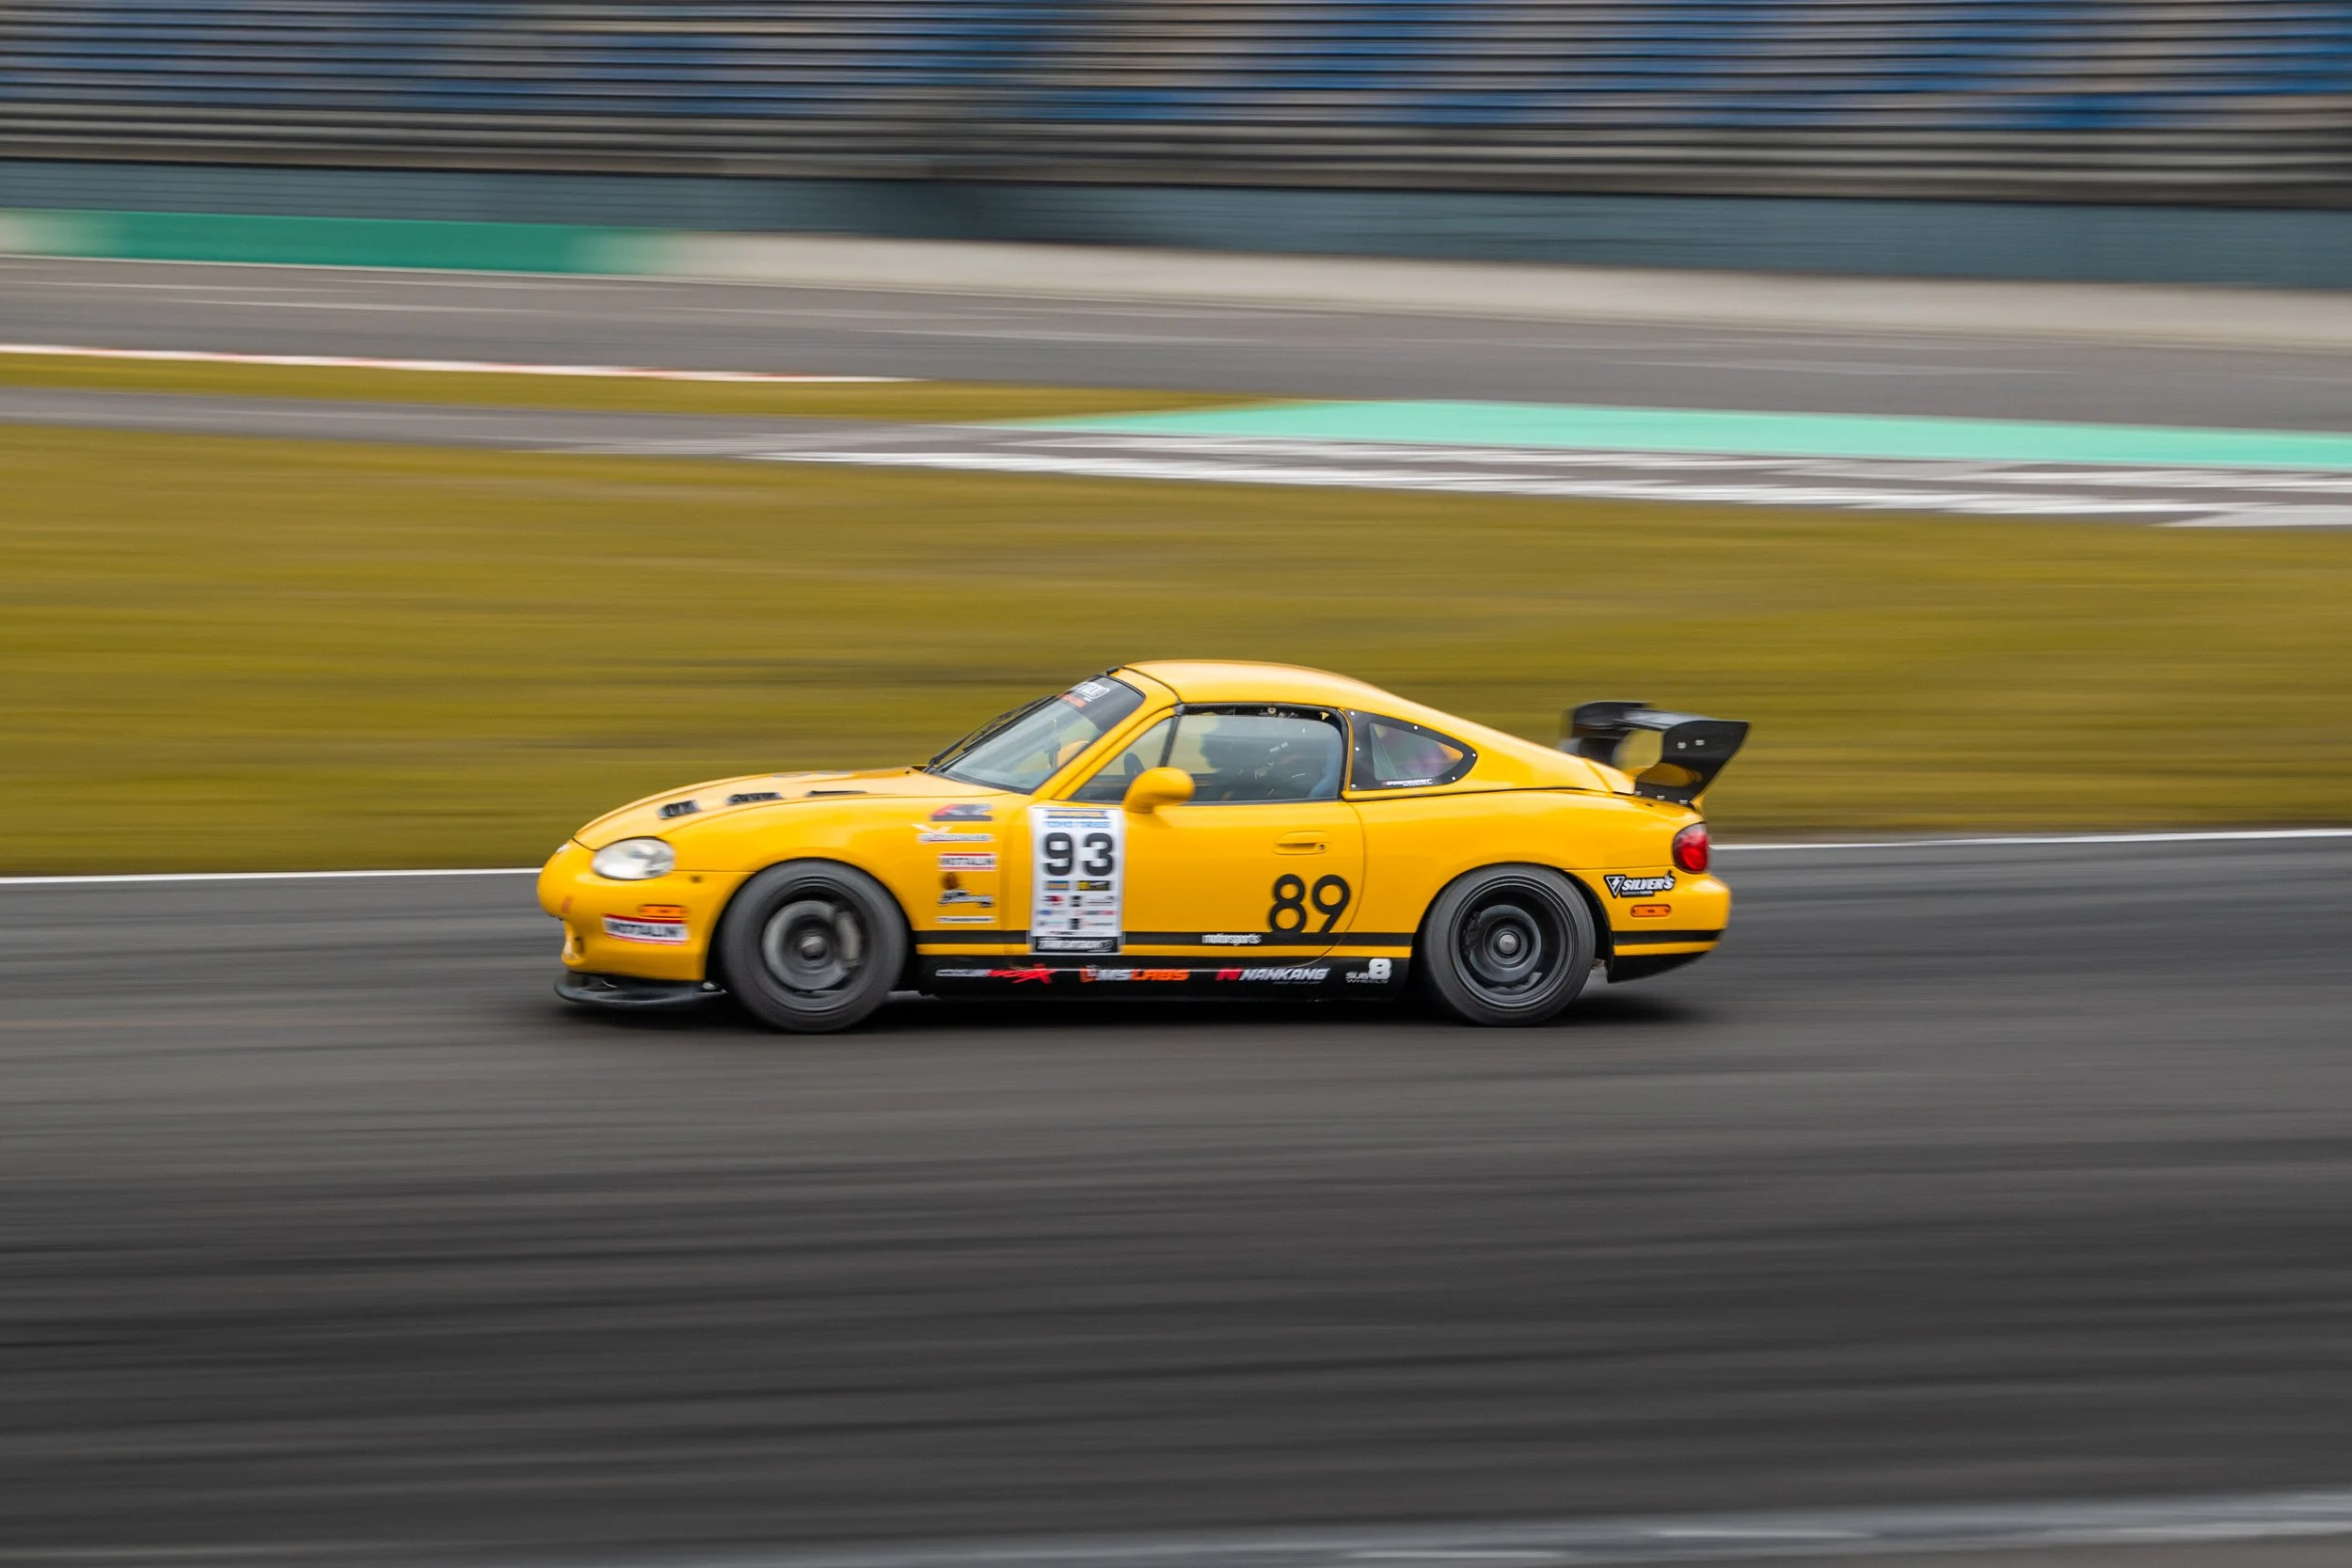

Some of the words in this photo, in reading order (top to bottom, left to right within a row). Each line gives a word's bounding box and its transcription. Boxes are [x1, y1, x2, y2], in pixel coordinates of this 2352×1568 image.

[1045, 832, 1114, 877] 93
[1268, 873, 1351, 934] 89
[1237, 967, 1330, 981] NANKANG
[1345, 971, 1370, 980] SUB
[1368, 958, 1391, 980] 8
